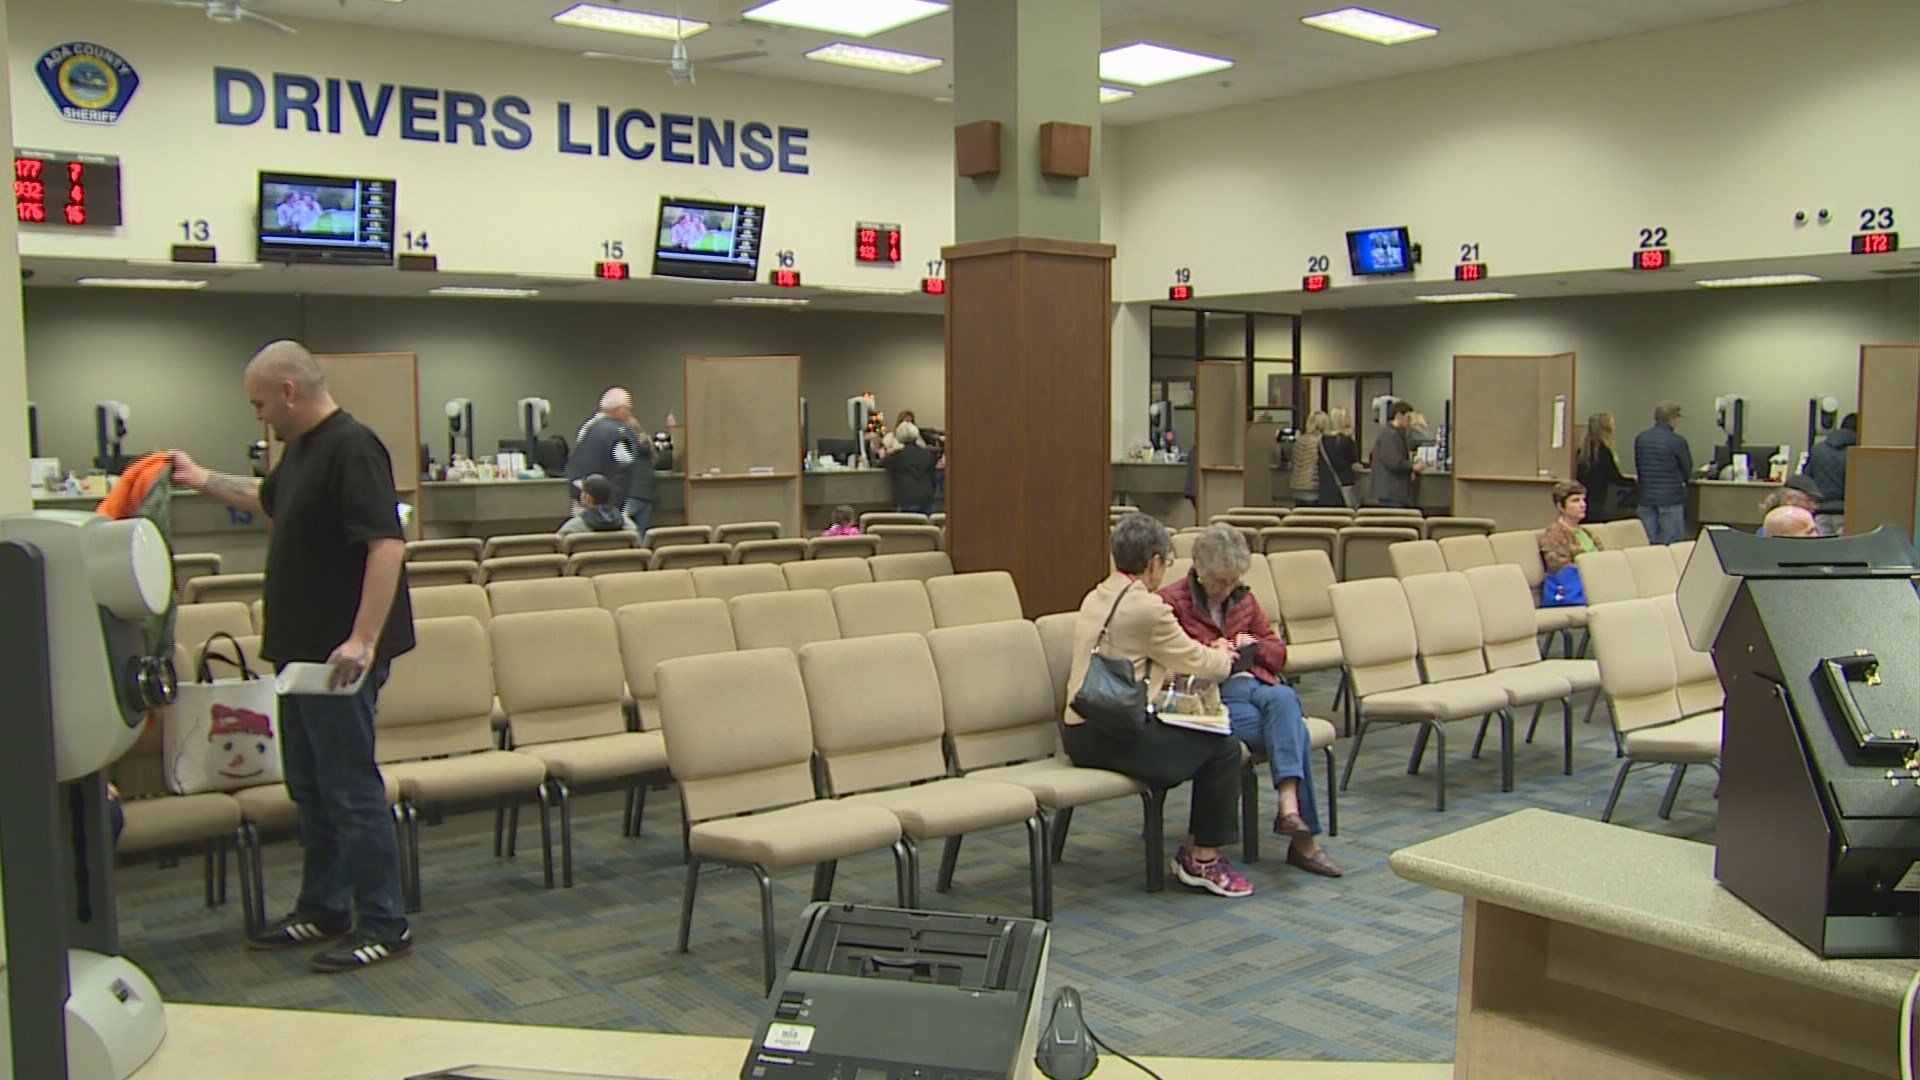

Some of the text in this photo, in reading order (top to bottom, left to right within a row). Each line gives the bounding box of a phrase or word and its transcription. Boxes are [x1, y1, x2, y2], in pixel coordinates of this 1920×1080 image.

[44, 43, 131, 75] ADA COUNTY
[62, 106, 118, 122] SHERIFF
[213, 65, 810, 175] DRIVERS LICENSE
[15, 158, 83, 182] 177 7
[14, 180, 44, 200] 932
[1860, 207, 1894, 230] 23
[179, 219, 209, 241] 13
[1640, 227, 1667, 248] 22
[404, 230, 429, 250] 14
[601, 240, 623, 259] 15
[1864, 234, 1888, 252] 172
[775, 250, 795, 267] 16
[1461, 242, 1479, 261] 21
[927, 260, 942, 276] 17
[1308, 255, 1329, 272] 20
[1175, 268, 1190, 283] 19
